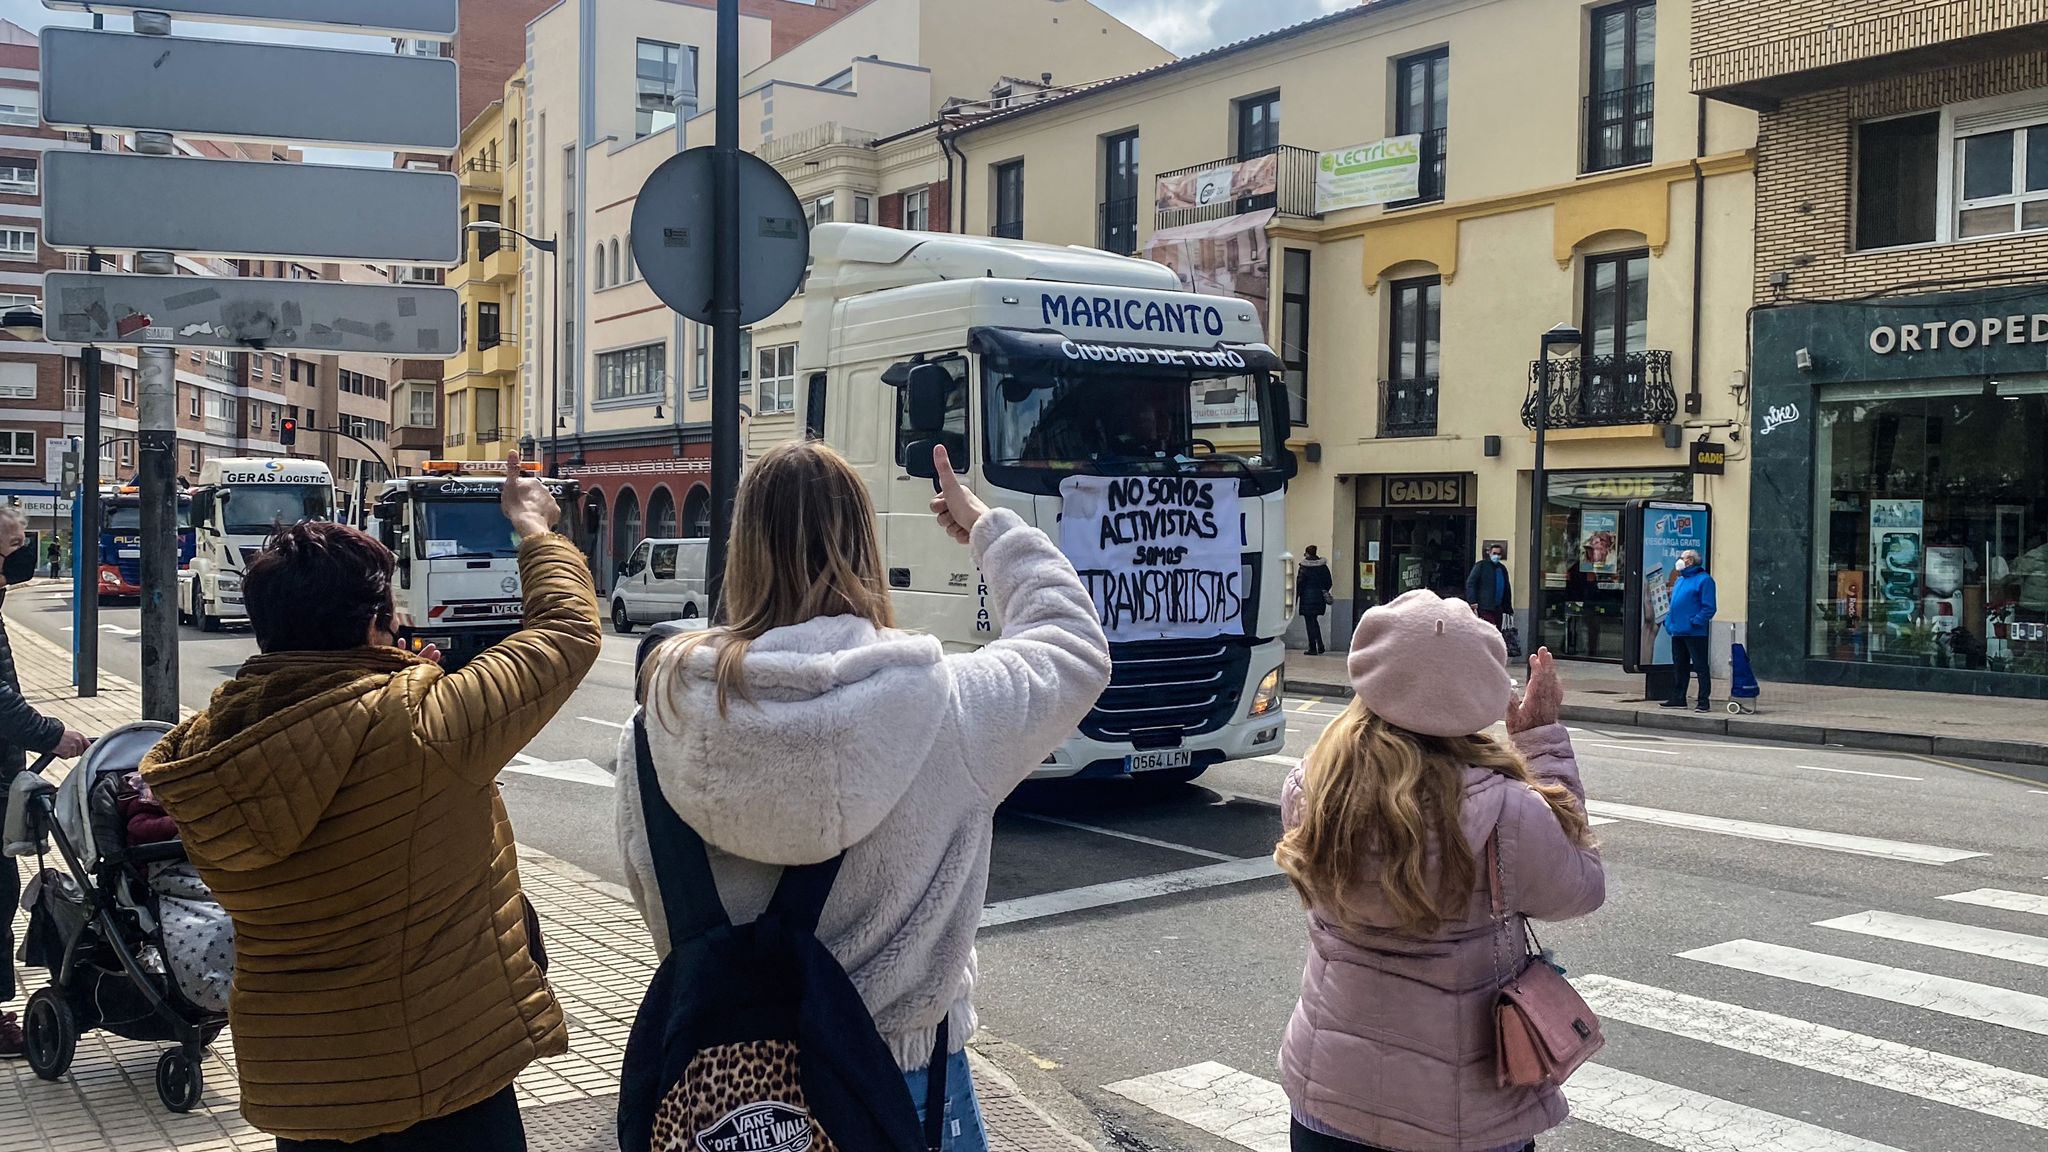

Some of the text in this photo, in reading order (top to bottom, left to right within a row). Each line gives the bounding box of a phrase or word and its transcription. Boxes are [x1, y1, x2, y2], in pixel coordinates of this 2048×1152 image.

[1041, 293, 1224, 336] MARICANTO
[1869, 313, 2048, 354] ORTOPED
[1061, 340, 1246, 368] CIUDAD DE TORO
[1697, 452, 1724, 465] GADIS
[227, 473, 326, 484] GERAS LOGISTIC
[1585, 478, 1655, 497] GADIS
[1108, 477, 1214, 511] NO SOMOS
[1390, 480, 1457, 501] GADIS
[1100, 507, 1218, 550] ACTIVISTAS
[1645, 537, 1701, 547] DESCARGA GRATIS
[1132, 545, 1188, 566] SOMOS
[1076, 568, 1241, 630] TRANSPORTISTAS
[1133, 751, 1190, 770] 0564 LFN
[731, 1108, 775, 1134] VANS
[739, 1127, 772, 1150] THE
